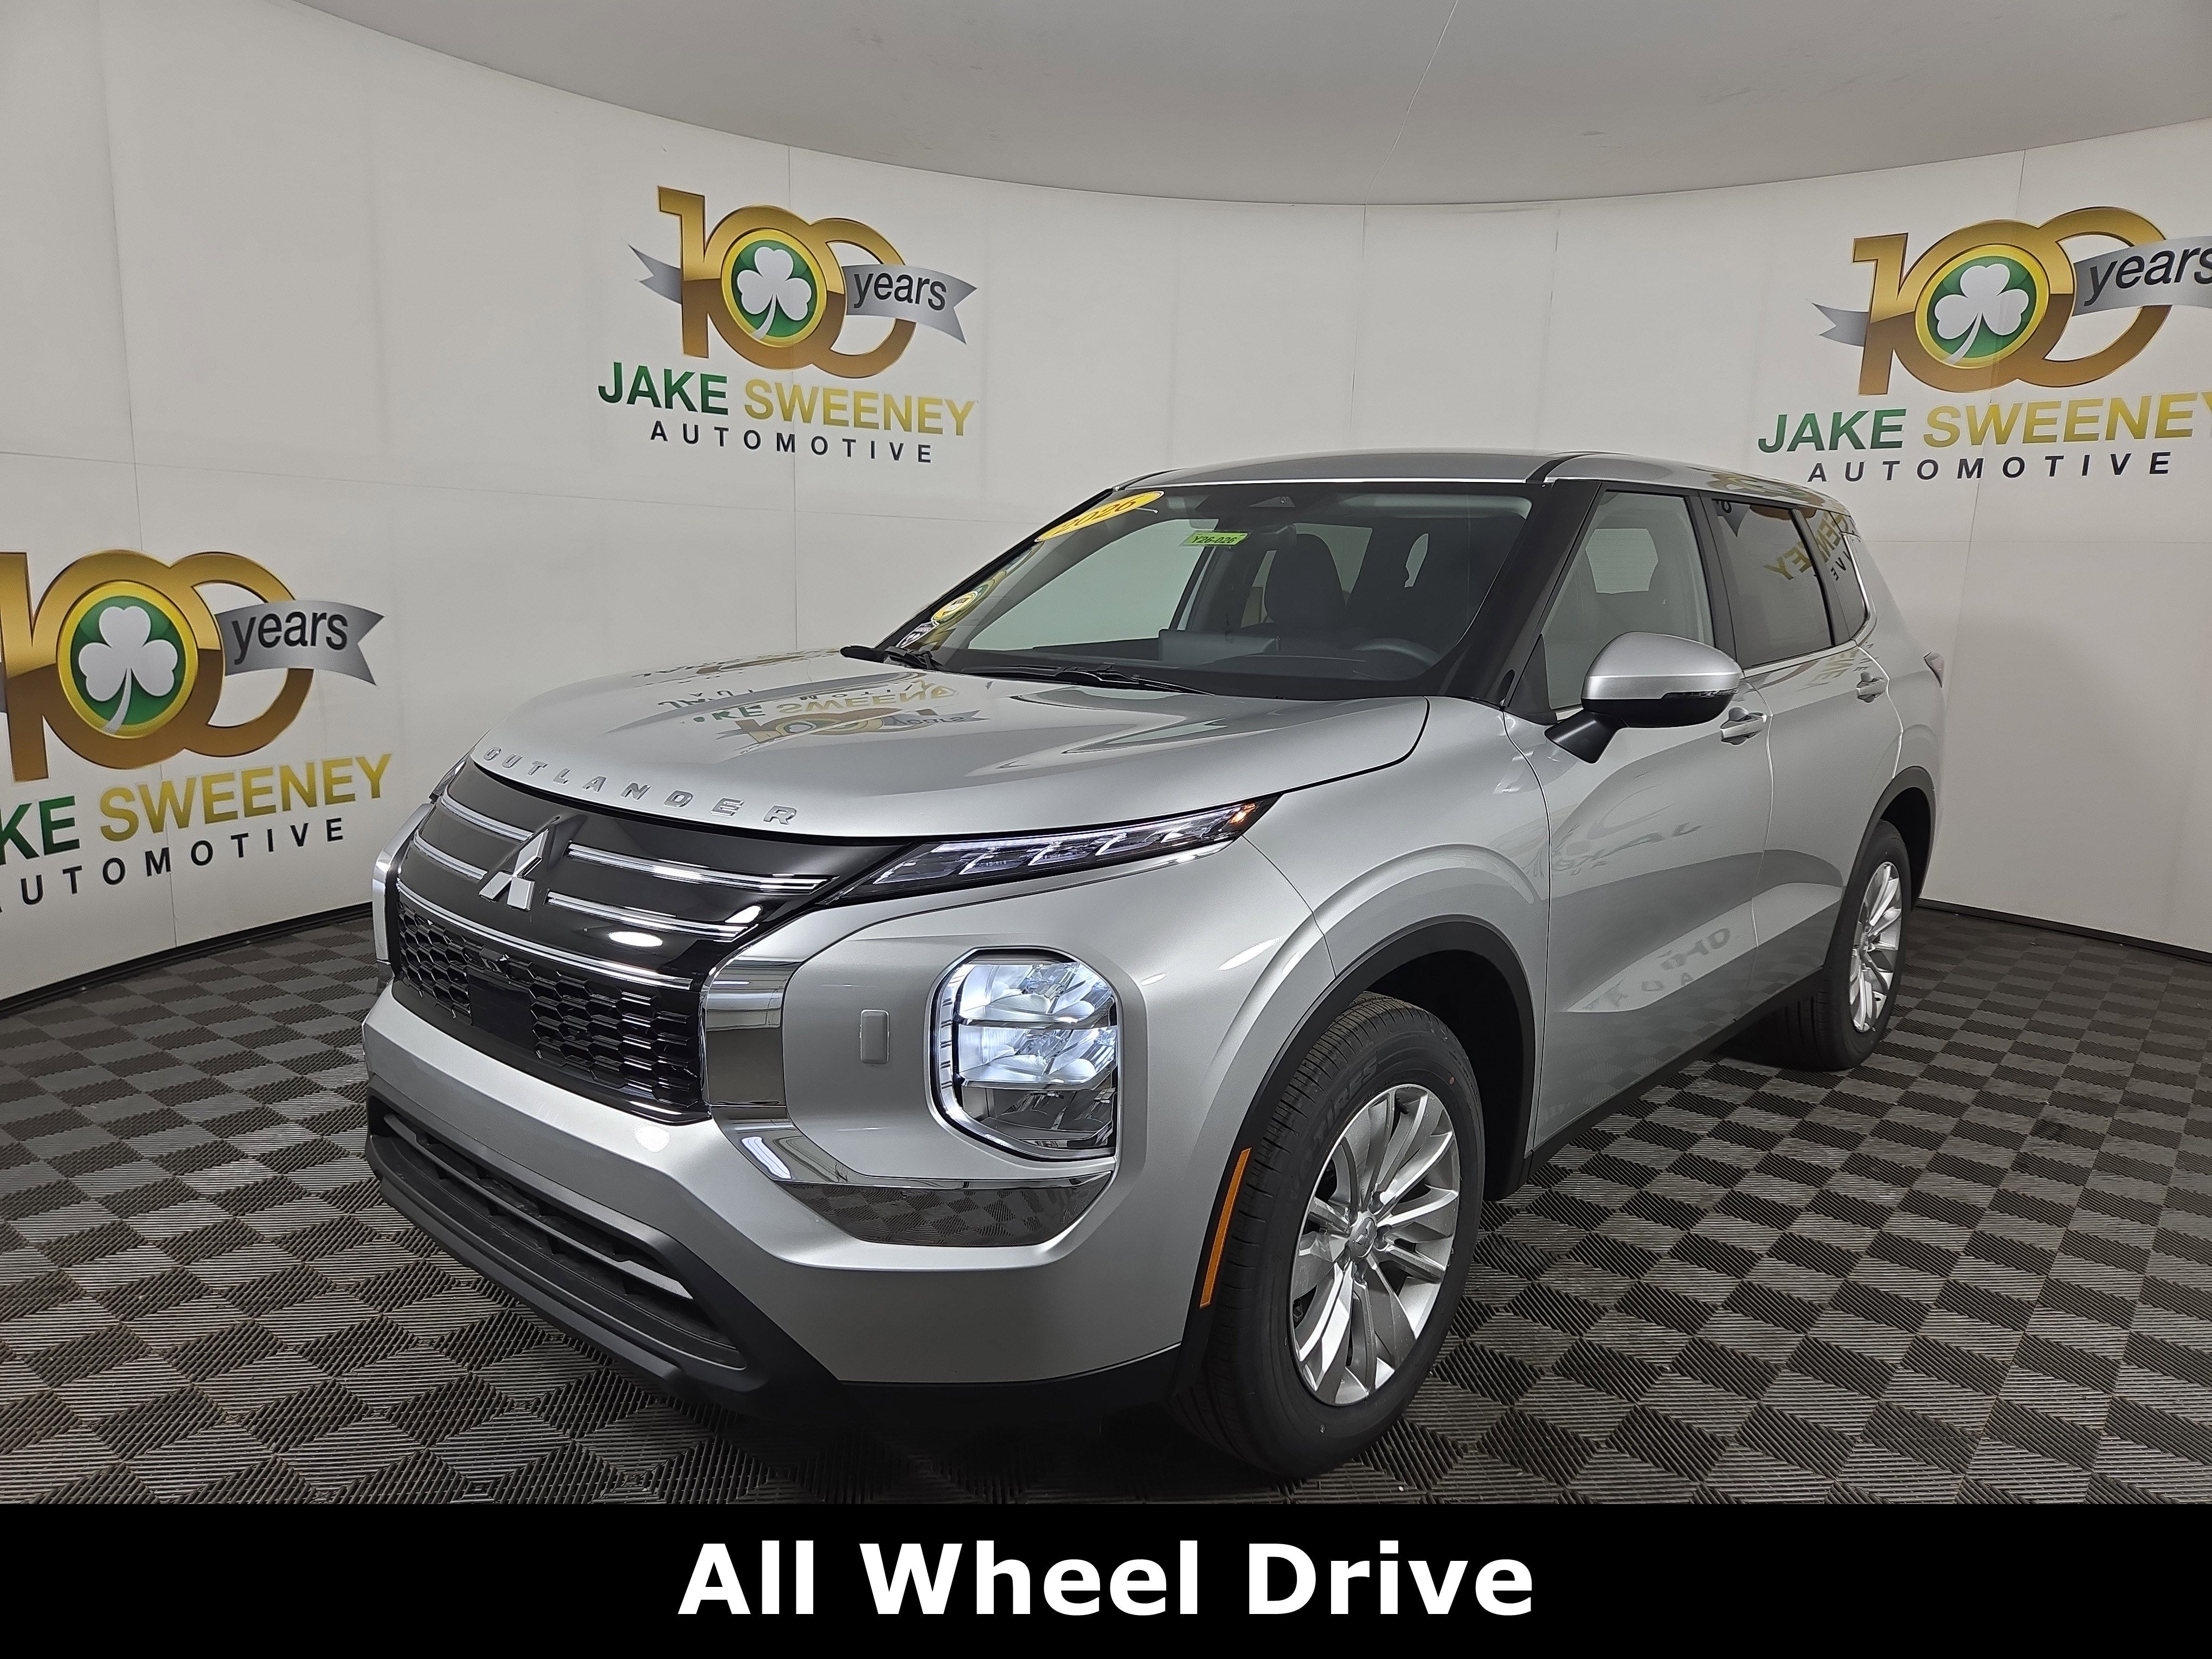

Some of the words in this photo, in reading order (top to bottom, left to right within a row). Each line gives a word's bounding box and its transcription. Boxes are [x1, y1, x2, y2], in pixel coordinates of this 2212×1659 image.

[854, 269, 947, 311] years
[598, 361, 729, 416] JAKE
[744, 380, 976, 436] SWEENEY
[1758, 408, 1907, 454] JAKE
[1923, 392, 2212, 449] SWEENE
[650, 420, 932, 464] AUTOMOTIVE
[1807, 451, 2172, 483] AUTOMOTIVE
[1052, 496, 1144, 535] 2026
[1192, 536, 1238, 544] Y26-026
[231, 611, 349, 666] years
[100, 754, 393, 842] SWEENEY
[483, 747, 797, 825] OUTLANDER
[0, 818, 343, 913] UTOMOTIVE
